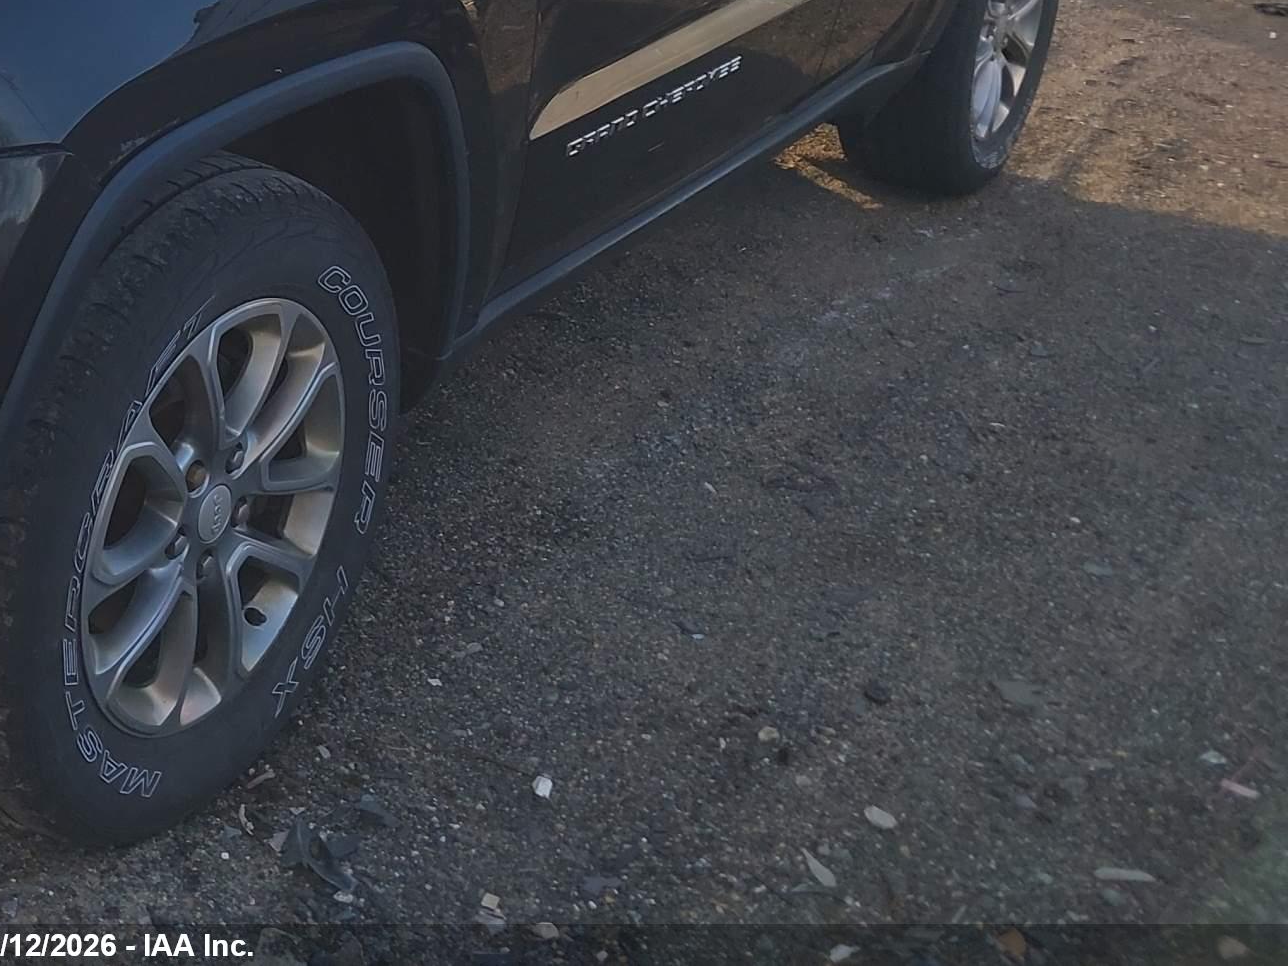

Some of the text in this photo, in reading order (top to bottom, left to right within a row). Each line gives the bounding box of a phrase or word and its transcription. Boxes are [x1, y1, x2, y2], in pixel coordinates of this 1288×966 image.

[567, 56, 742, 156] GRAND CHEROKEE
[271, 265, 388, 719] COURSER HSX
